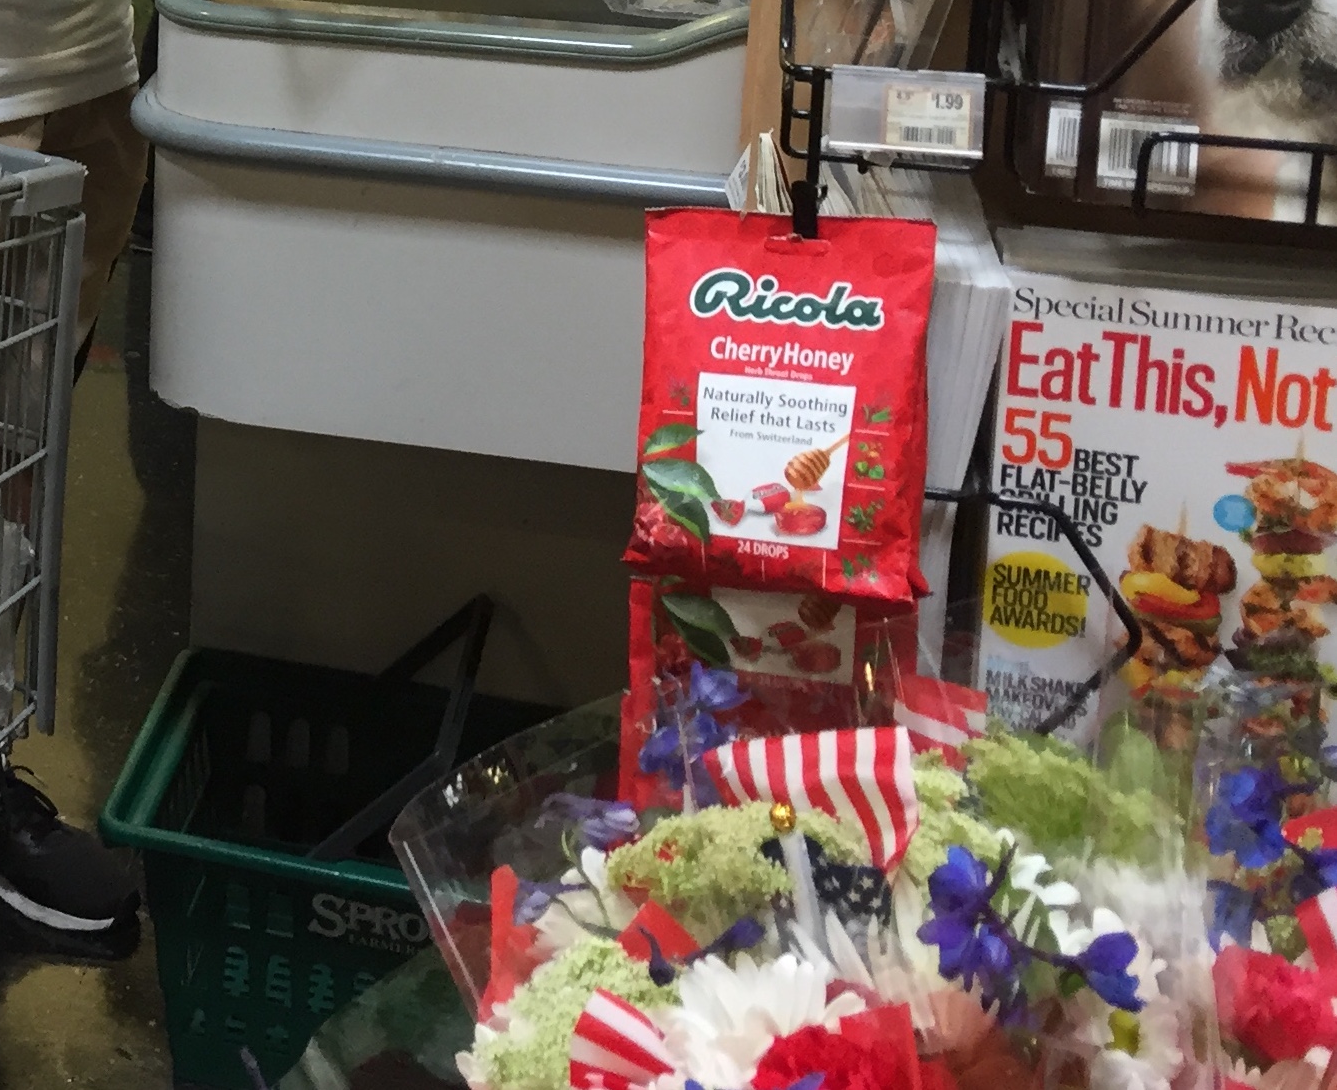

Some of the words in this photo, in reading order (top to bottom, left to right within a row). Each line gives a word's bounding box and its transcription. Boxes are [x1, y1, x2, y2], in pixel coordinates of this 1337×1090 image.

[691, 268, 884, 330] Ricola
[1013, 287, 1124, 323] Special
[1129, 299, 1269, 338] Summer
[790, 370, 813, 381] Drops
[1005, 320, 1100, 405] Eat
[1101, 330, 1229, 429] This,
[1234, 344, 1337, 432] Not
[703, 386, 774, 409] Naturally
[778, 393, 848, 417] Soothing
[710, 406, 756, 423] Relief
[760, 412, 791, 428] that
[796, 415, 836, 433] Lasts
[729, 429, 754, 440] From
[756, 431, 813, 446] Switzerland
[1002, 406, 1073, 470] 55
[1073, 448, 1140, 478] BEST
[1000, 463, 1148, 504] FLAT-BELLY
[737, 539, 751, 554] 24
[753, 541, 789, 560] DROPS
[993, 563, 1091, 596] SUMMER
[992, 585, 1049, 611] FOOD
[990, 604, 1087, 639] AWARDS!
